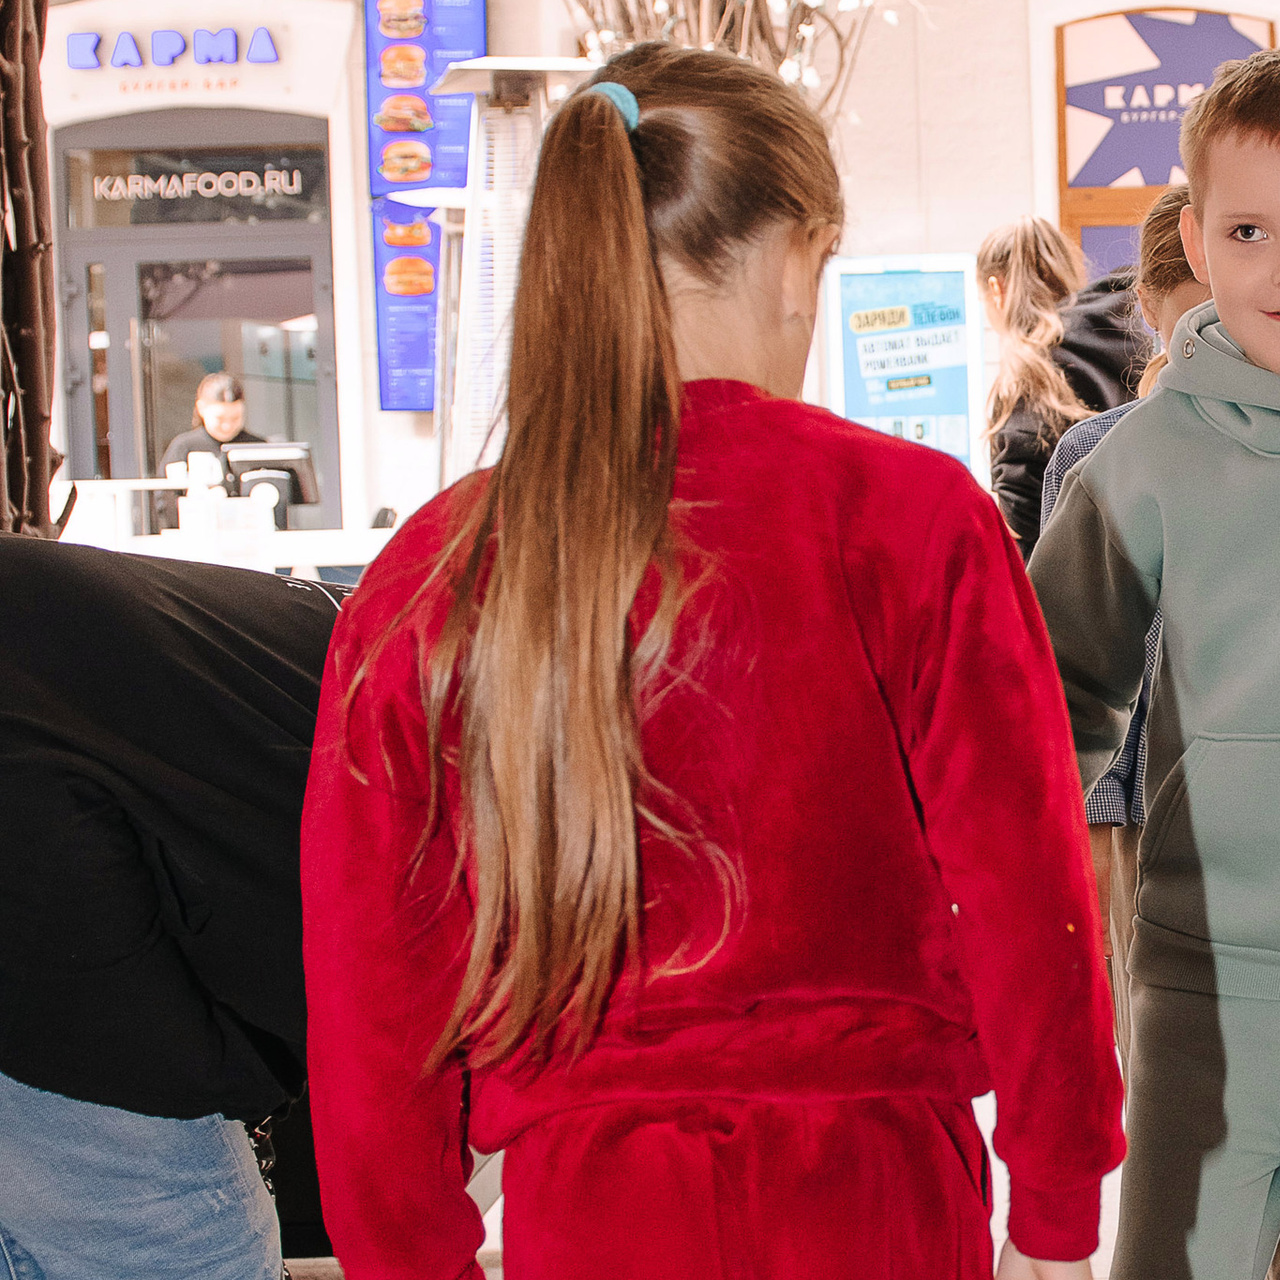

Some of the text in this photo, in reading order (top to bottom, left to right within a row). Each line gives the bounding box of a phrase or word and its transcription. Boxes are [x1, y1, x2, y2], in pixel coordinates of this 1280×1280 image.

[67, 26, 279, 70] КАРМА
[1103, 82, 1206, 110] КАРМ
[93, 169, 303, 201] KARMAFOOD.RU
